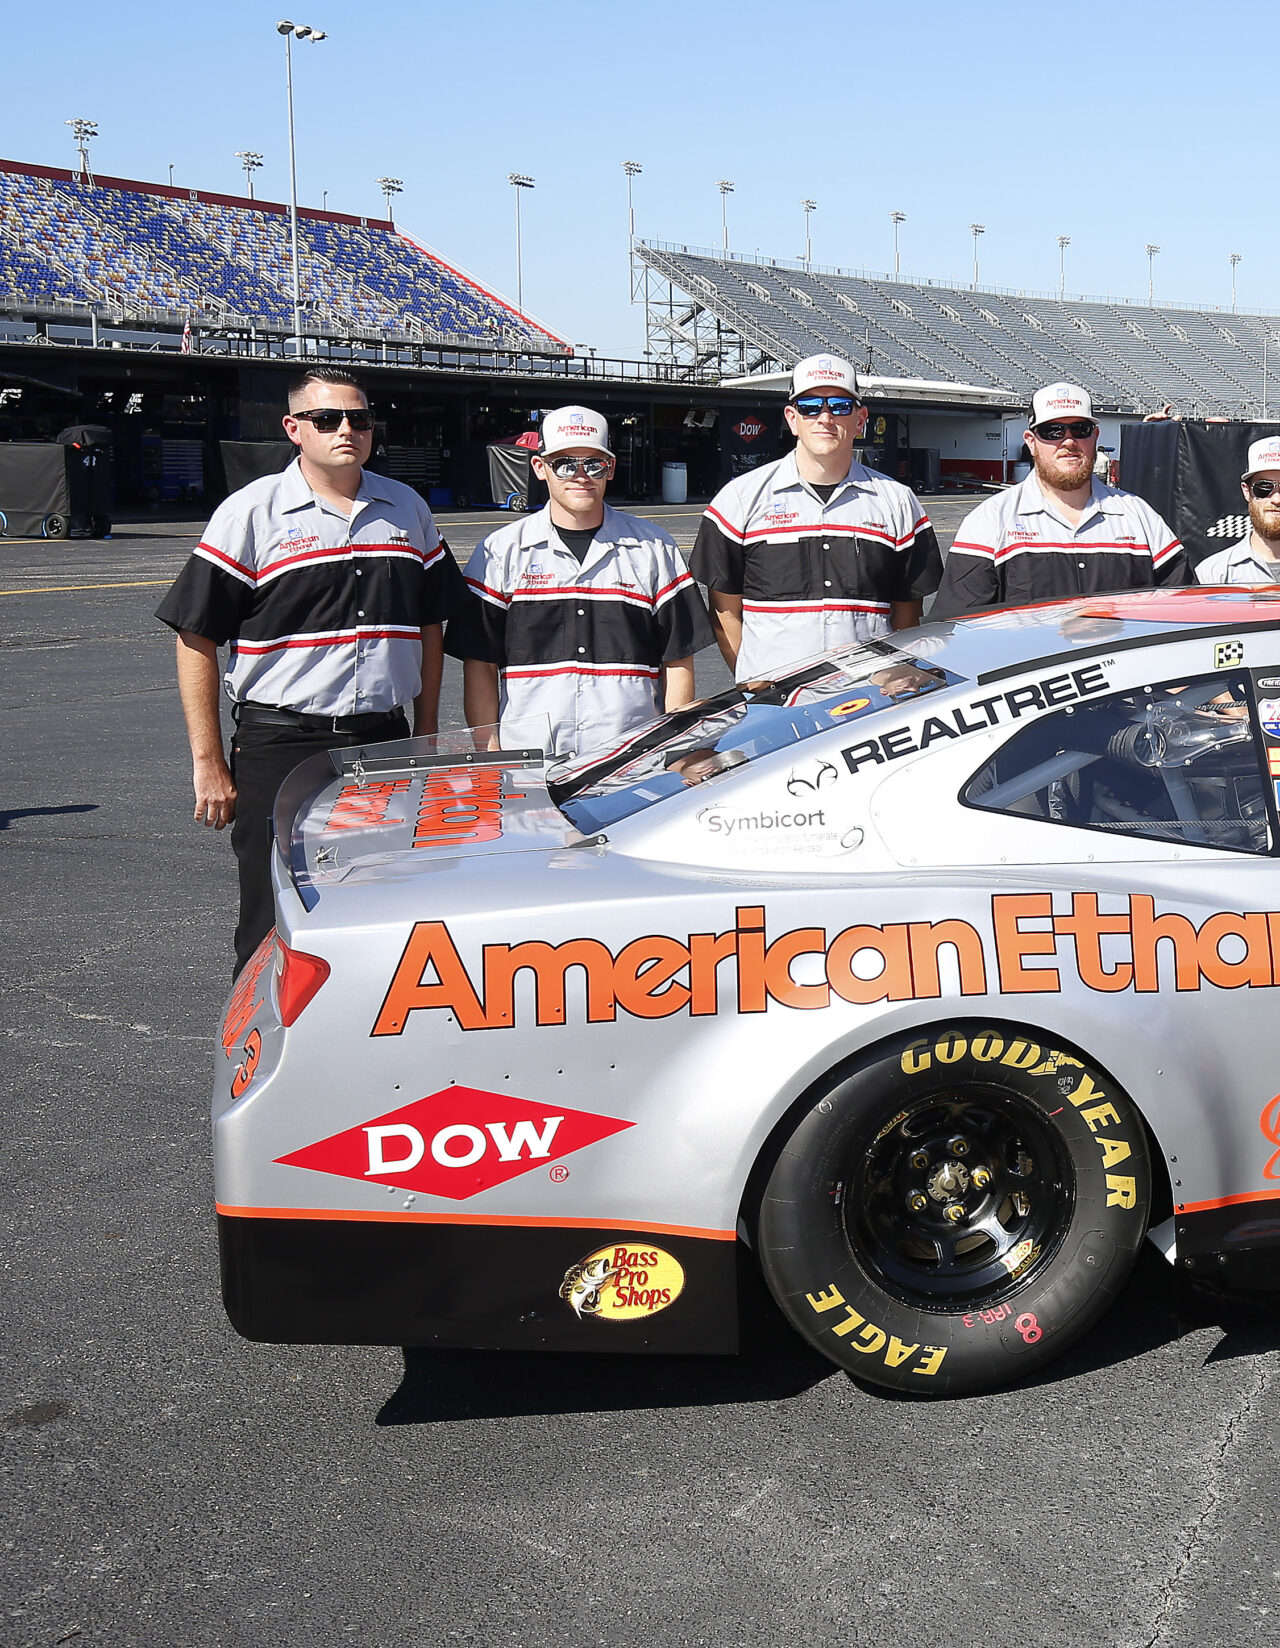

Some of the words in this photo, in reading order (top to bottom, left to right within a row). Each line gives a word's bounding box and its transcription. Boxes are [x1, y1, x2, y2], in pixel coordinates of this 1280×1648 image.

[807, 369, 845, 379] American
[557, 424, 598, 433] American
[740, 422, 761, 435] DOW
[764, 512, 800, 521] American
[279, 535, 320, 551] American
[289, 542, 313, 553] Ethanol
[521, 572, 556, 580] American
[841, 663, 1111, 775] REALTREE
[708, 809, 826, 836] Symbicort
[369, 905, 988, 1038] American
[230, 1027, 262, 1100] 3
[361, 1116, 565, 1177] DOW
[611, 1247, 659, 1268] Bass
[612, 1266, 649, 1288] Pro
[613, 1285, 672, 1311] Shops
[805, 1283, 949, 1376] EAGLE
